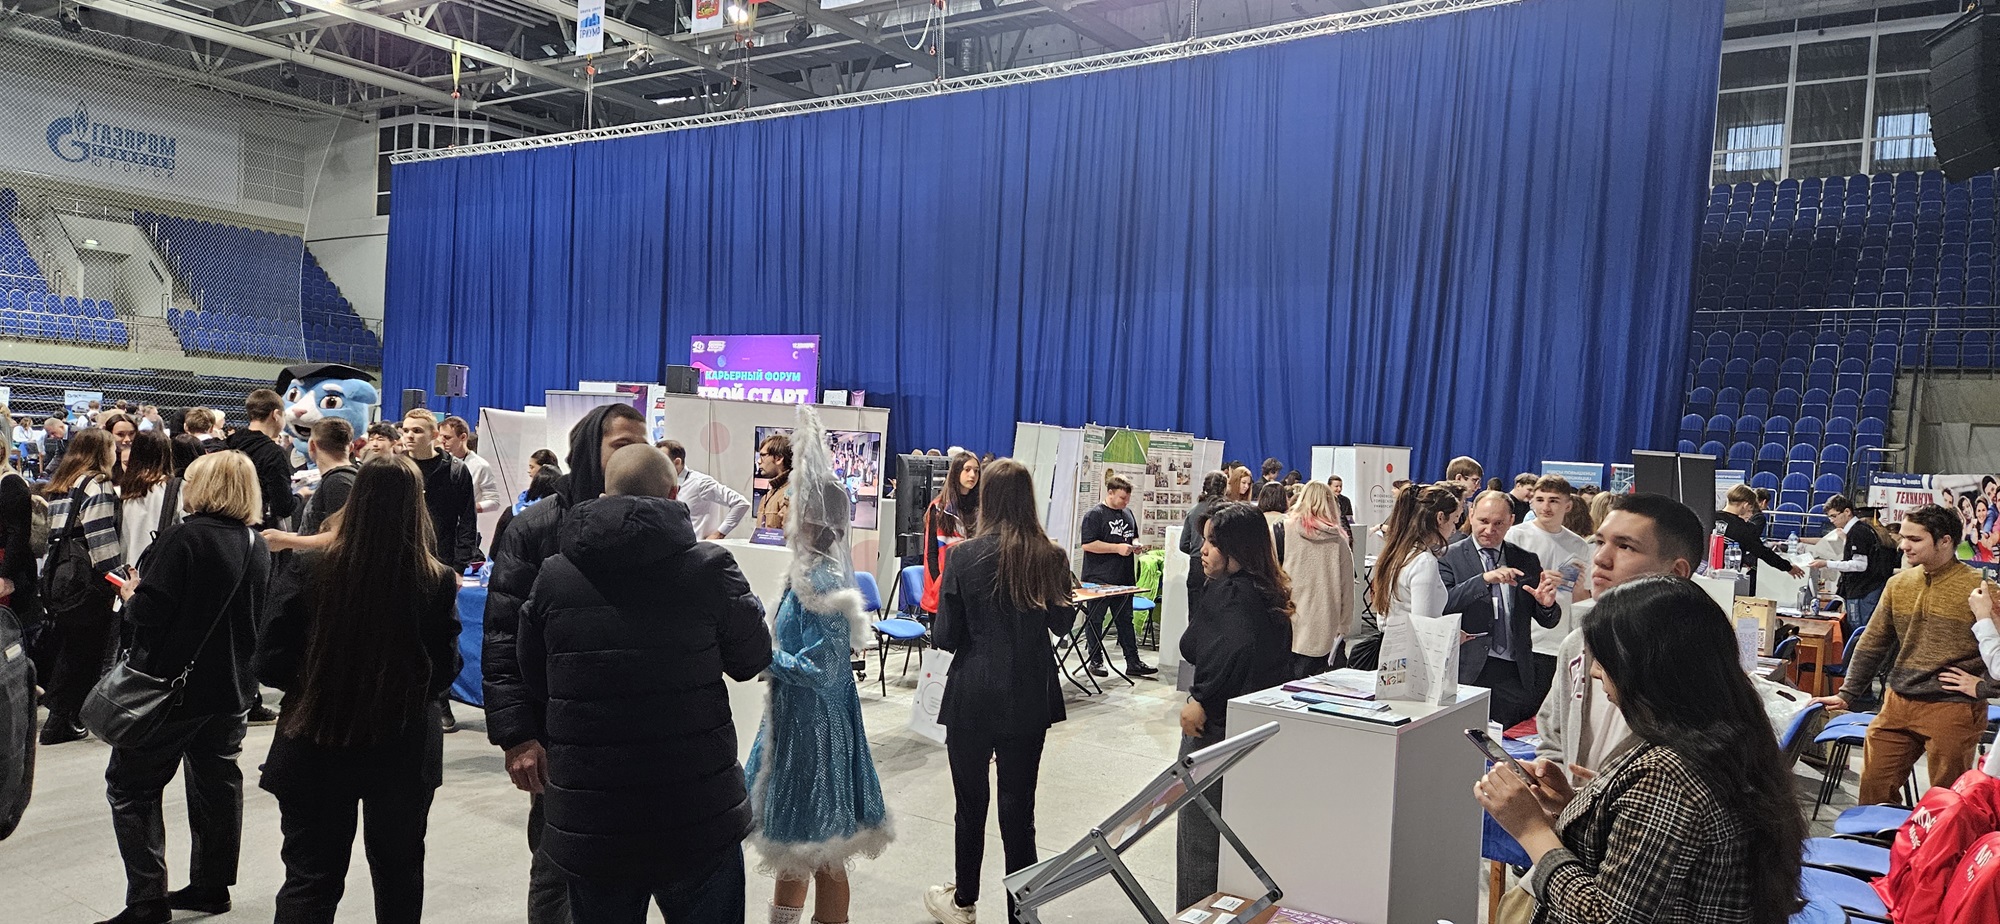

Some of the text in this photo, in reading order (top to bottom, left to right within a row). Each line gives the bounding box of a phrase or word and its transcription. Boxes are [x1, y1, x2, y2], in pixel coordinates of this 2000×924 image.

[92, 121, 176, 158] ГАЗПРОМ
[705, 369, 801, 382] КАРЬЕРНЫЙ ФОРУМ
[697, 382, 809, 404] ТВОЙ СТАРТ
[1895, 491, 1934, 506] ТЕХНИКУМ
